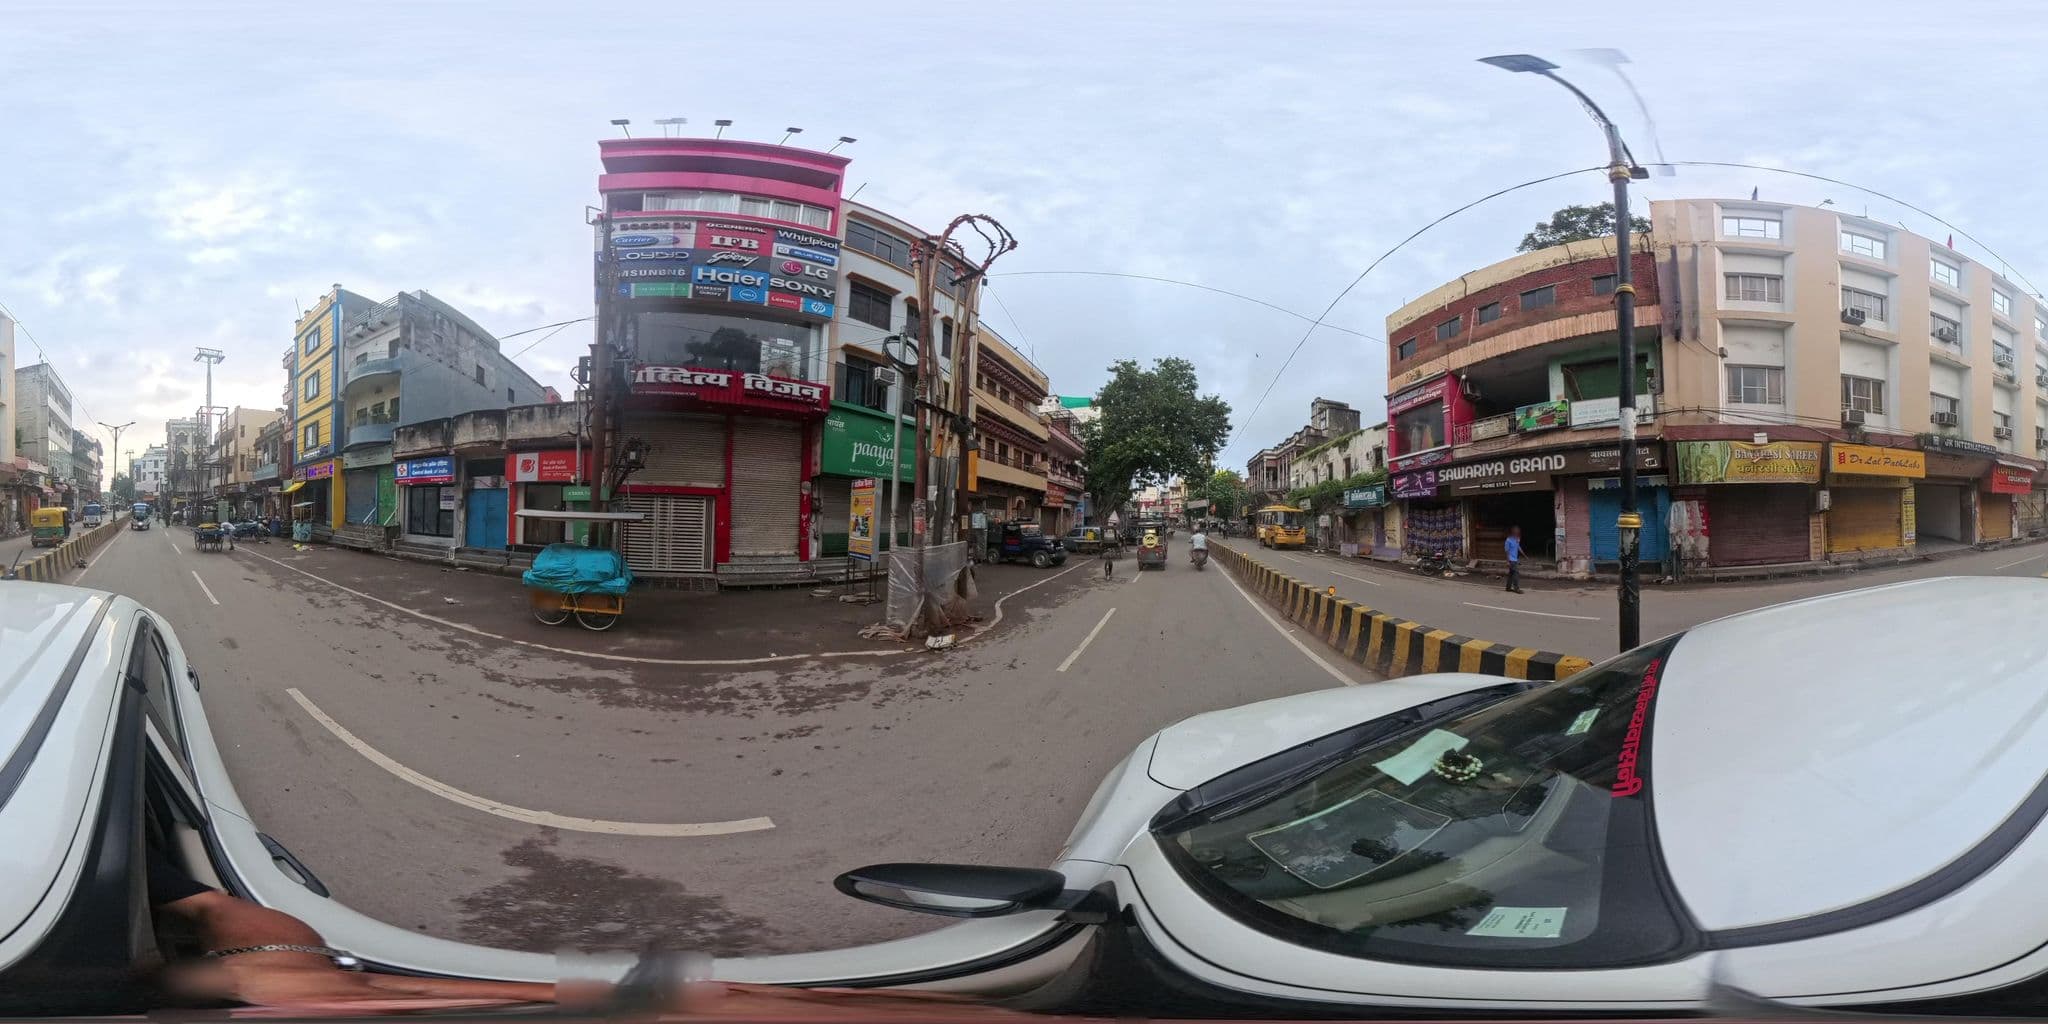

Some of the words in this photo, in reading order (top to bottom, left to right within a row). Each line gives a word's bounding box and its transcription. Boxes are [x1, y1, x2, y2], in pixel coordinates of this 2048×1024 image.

[711, 235, 759, 250] IFB
[778, 230, 838, 250] Whirlpool
[697, 267, 765, 286] Haier
[804, 265, 829, 280] LG
[770, 277, 835, 298] SONY
[1438, 461, 1505, 482] SAWARIYA
[1510, 455, 1566, 474] GRAND
[1864, 456, 1881, 464] Lal
[1882, 457, 1920, 469] PathLabs
